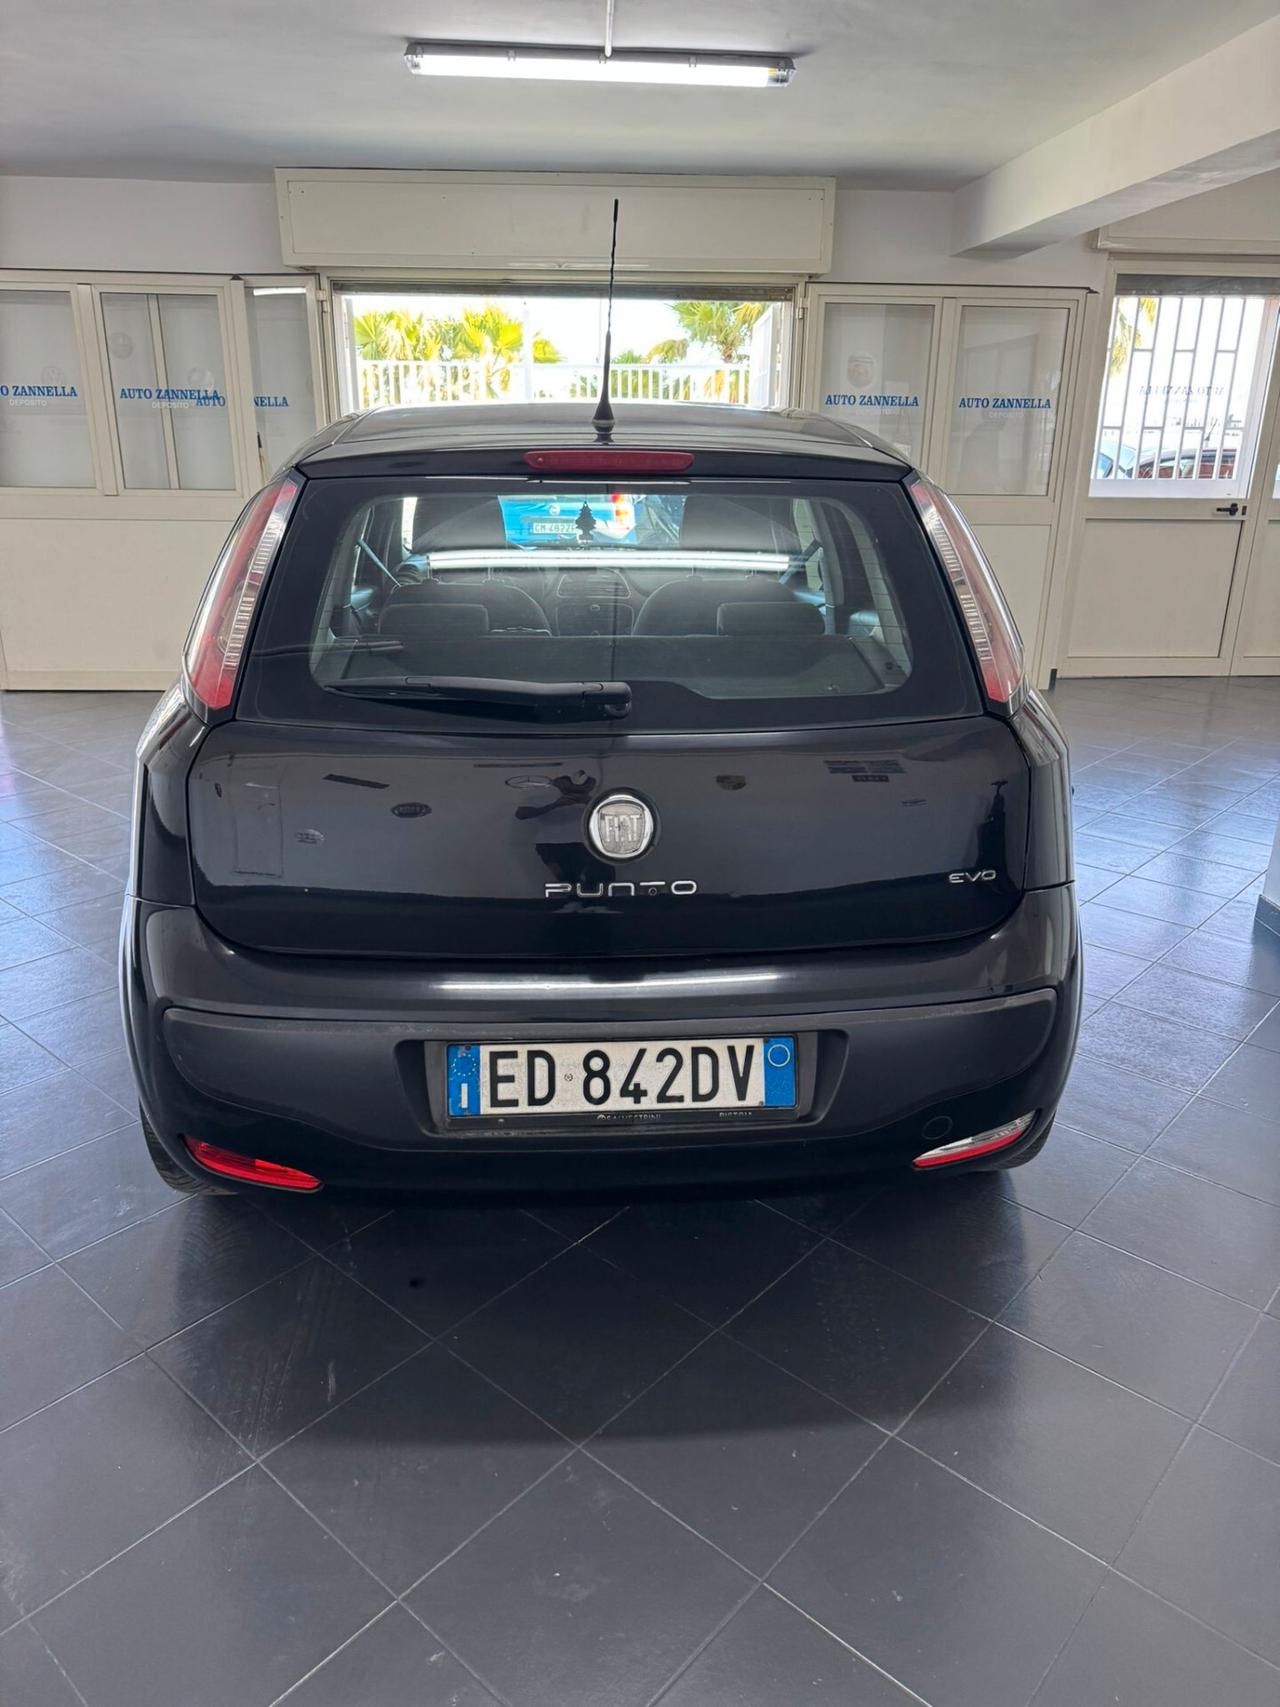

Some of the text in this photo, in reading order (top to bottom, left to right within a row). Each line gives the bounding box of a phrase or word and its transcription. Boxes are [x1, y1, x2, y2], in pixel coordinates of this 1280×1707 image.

[12, 385, 78, 397] ZANNELLA
[120, 388, 220, 400] AUTO ZANNELLA
[253, 396, 289, 407] NELLA
[825, 394, 919, 407] AUTO ZANNELLA
[959, 397, 1051, 409] AUTO ZANNELLA
[603, 814, 641, 842] FIAT
[948, 870, 996, 883] EVO
[545, 880, 697, 897] PUNTO
[489, 1049, 556, 1108] ED
[582, 1044, 755, 1106] 842DV
